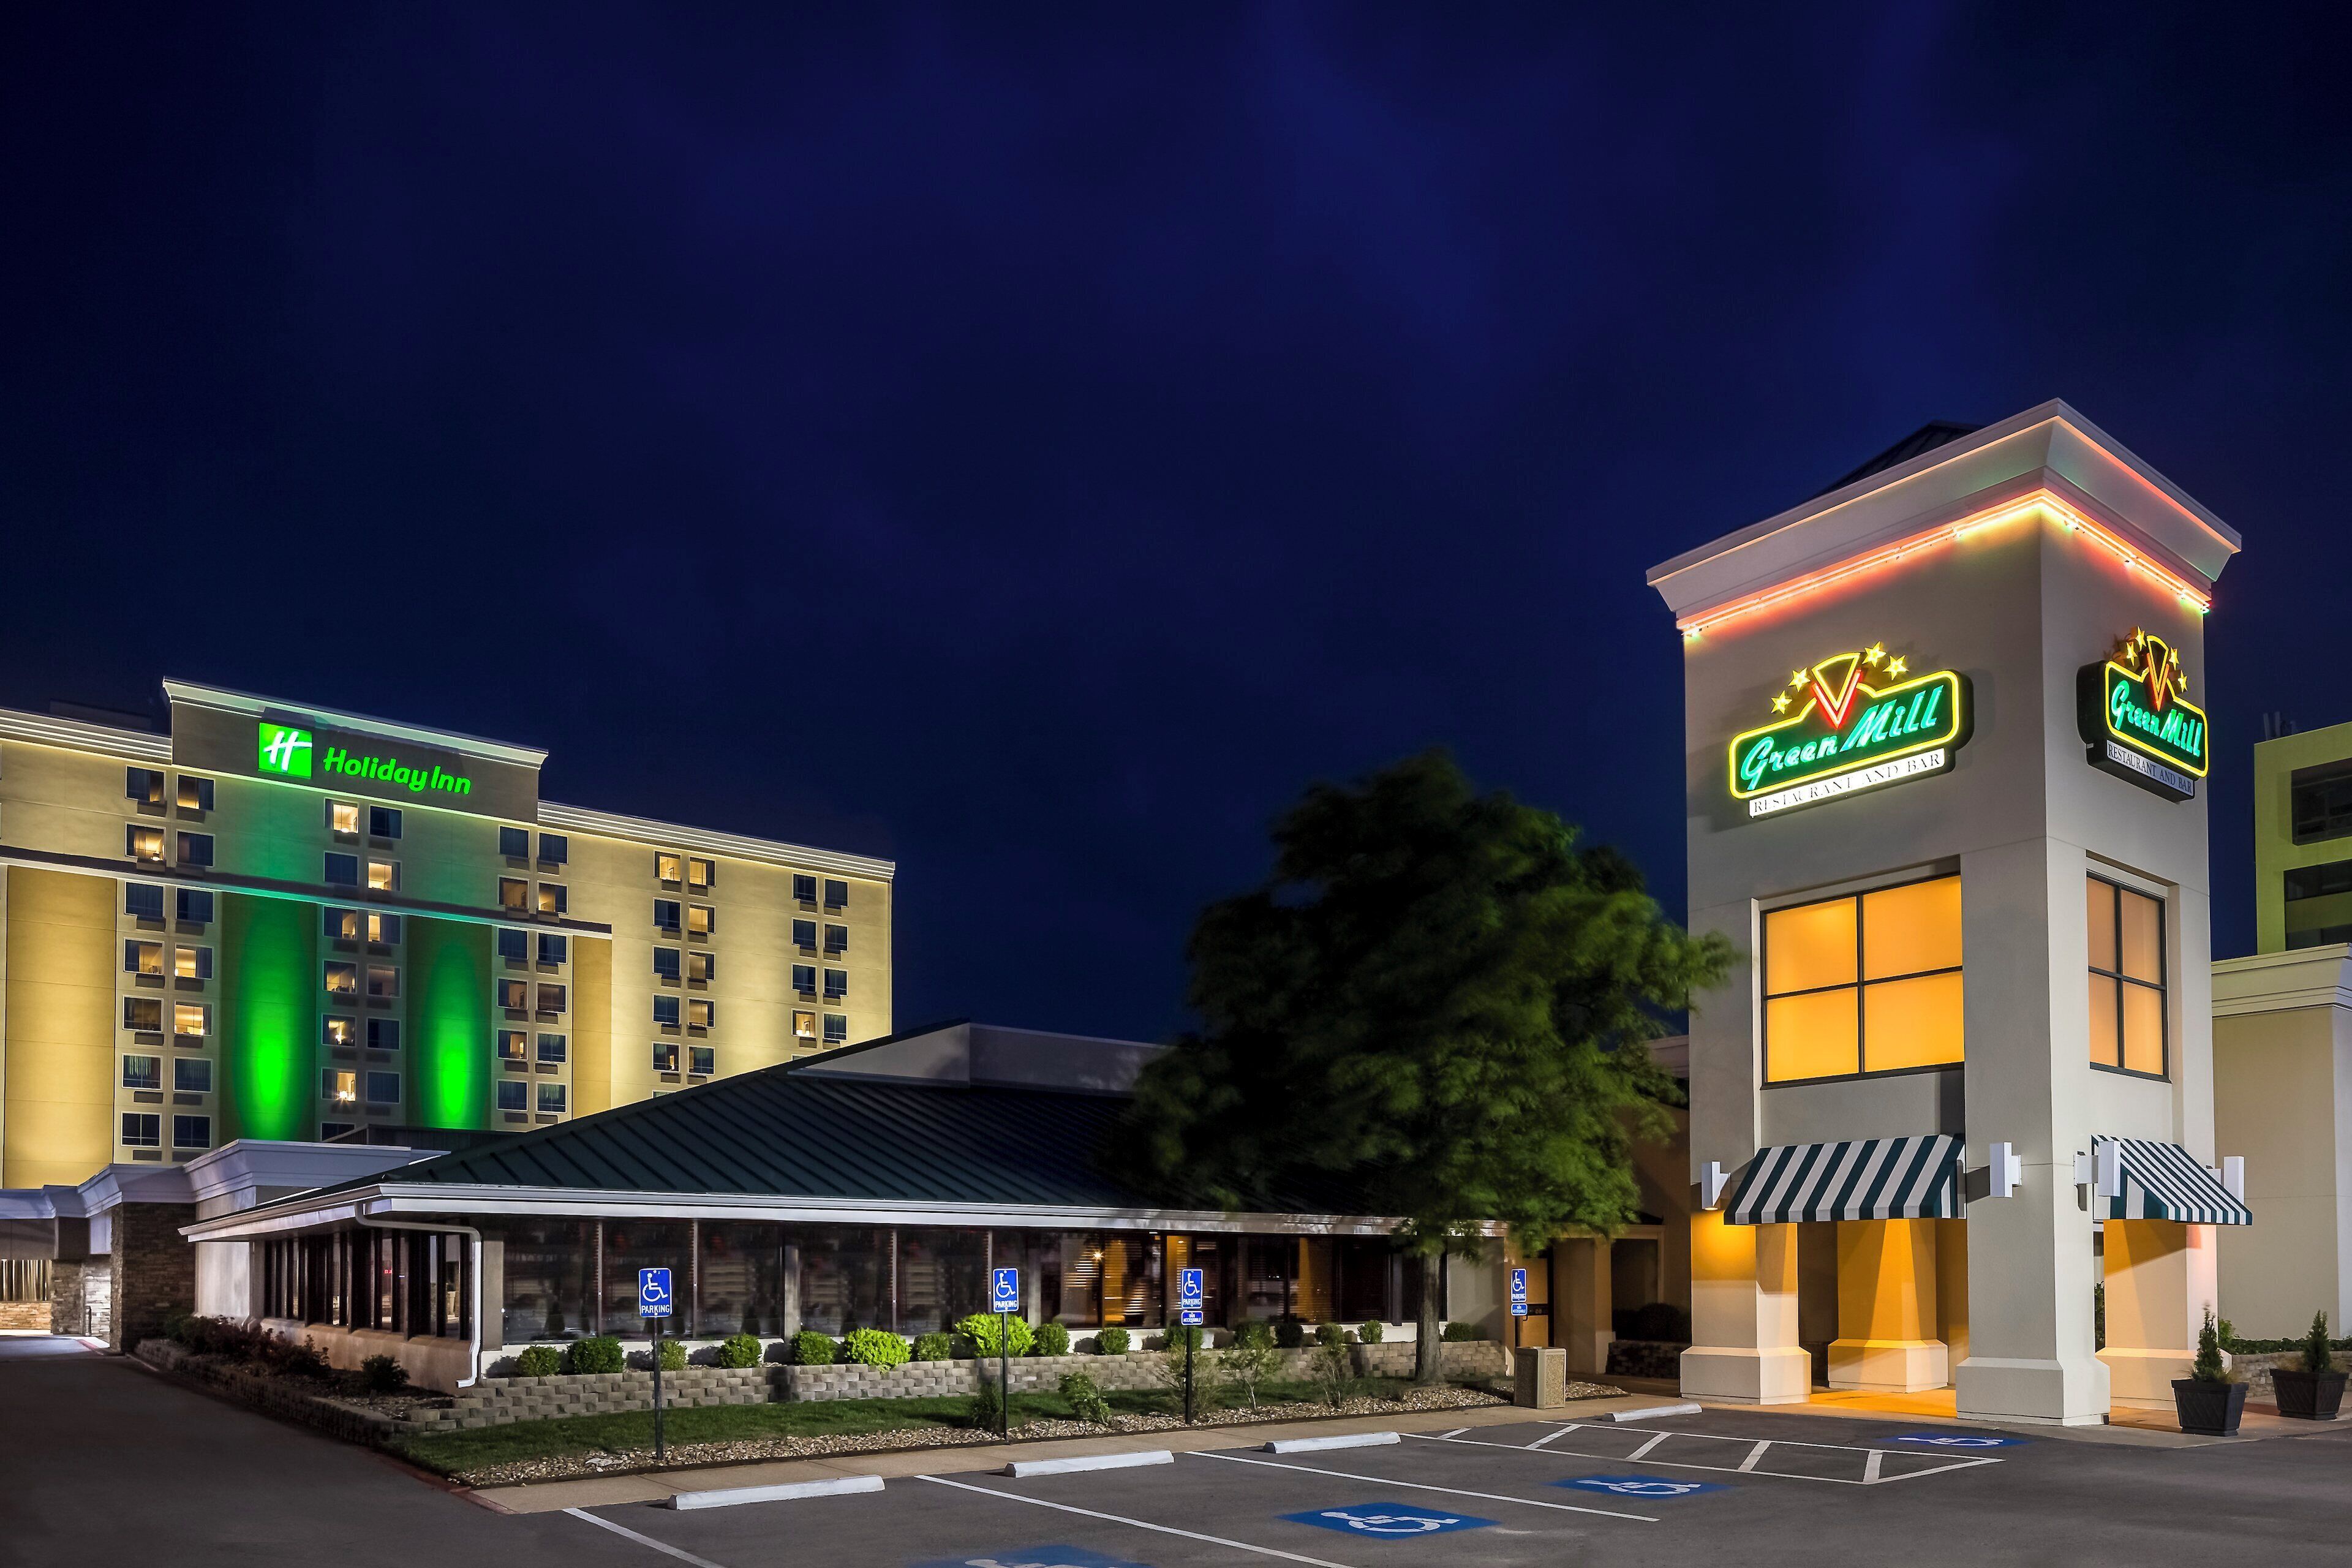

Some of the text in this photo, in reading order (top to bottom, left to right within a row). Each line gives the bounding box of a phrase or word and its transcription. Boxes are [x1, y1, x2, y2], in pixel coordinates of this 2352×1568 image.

[1740, 685, 1944, 790] Green Mill
[2111, 680, 2203, 757] Green Mill
[323, 747, 471, 795] Holiday Inn
[1754, 753, 1940, 812] RESTAURANT AND BAR
[2108, 743, 2192, 793] RESTAURANT AND BAR
[641, 1305, 669, 1313] PARKING
